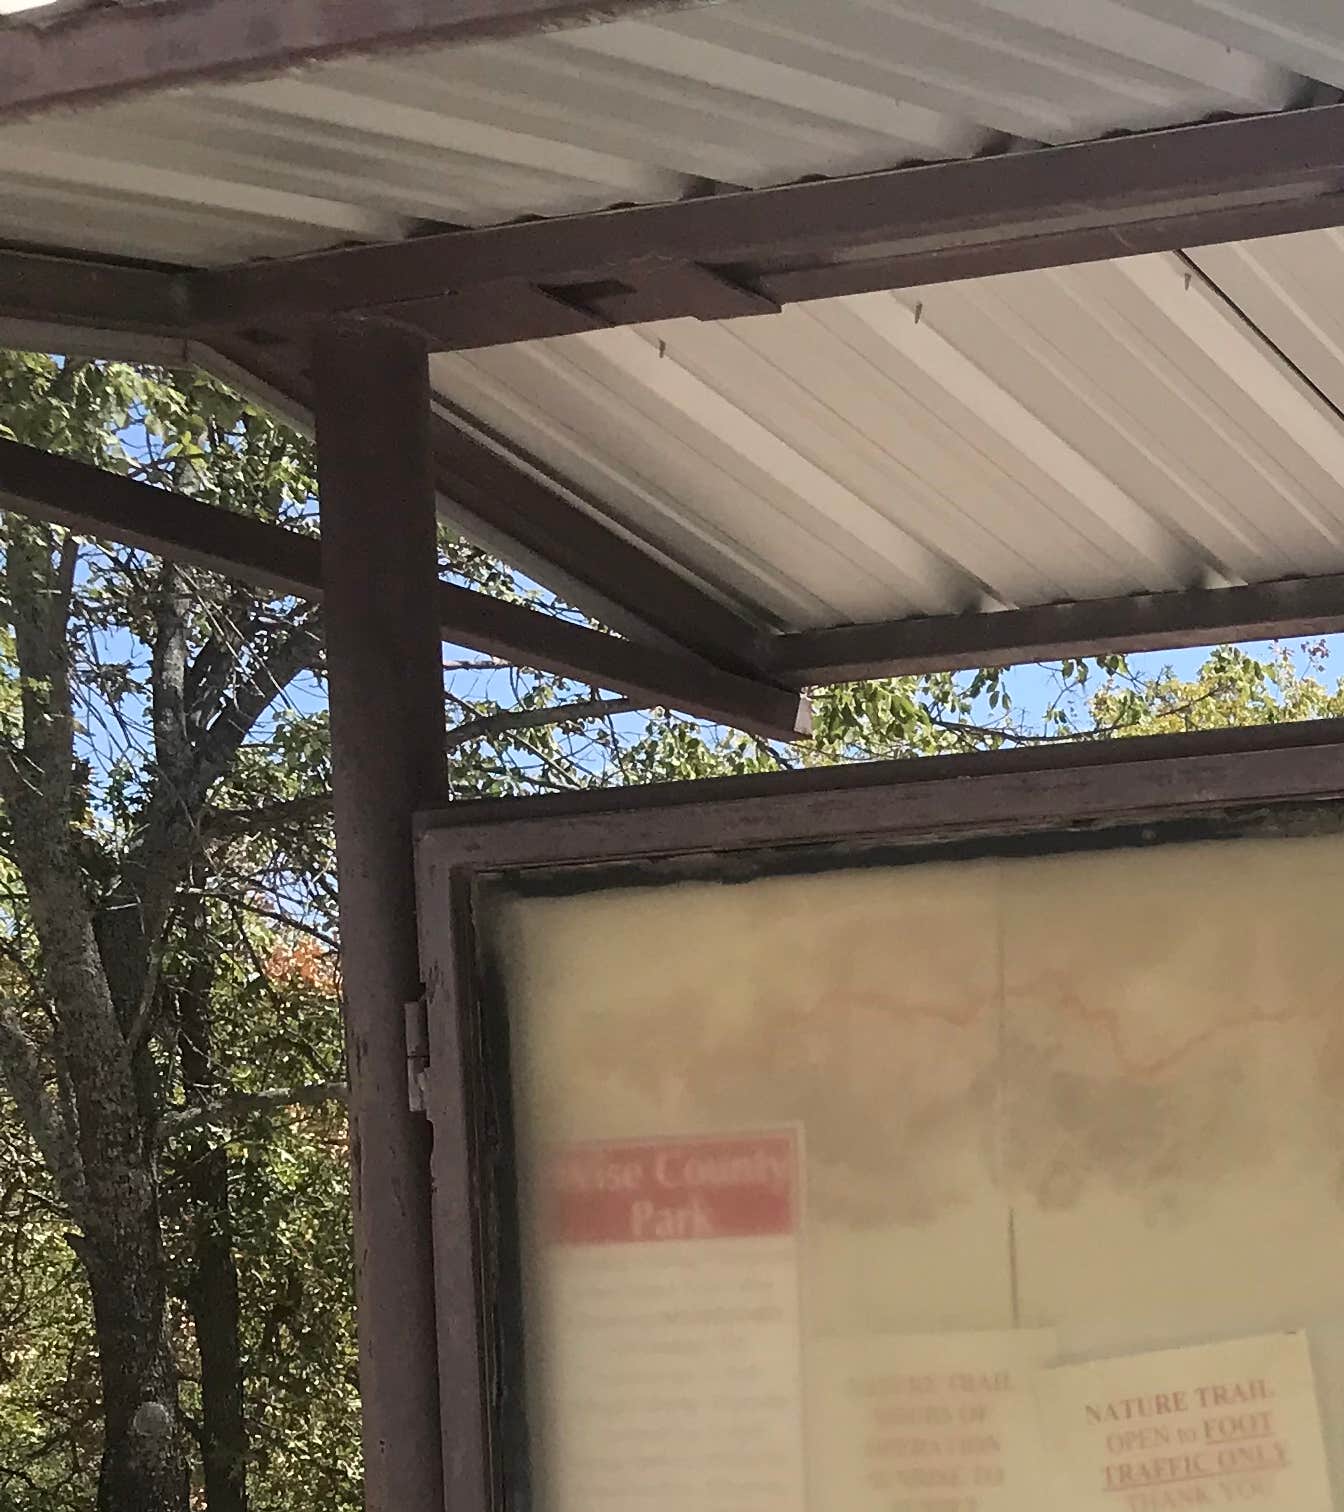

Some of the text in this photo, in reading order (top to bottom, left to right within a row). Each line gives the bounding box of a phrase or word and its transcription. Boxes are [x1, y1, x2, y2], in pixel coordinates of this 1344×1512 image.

[656, 1147, 788, 1190] County
[631, 1196, 712, 1240] Park
[1085, 1379, 1276, 1423] NATURE TRAIL
[1106, 1425, 1170, 1454] OPEN
[1203, 1412, 1275, 1443] FOOT
[1102, 1441, 1292, 1492] TRAFFIC ONLY
